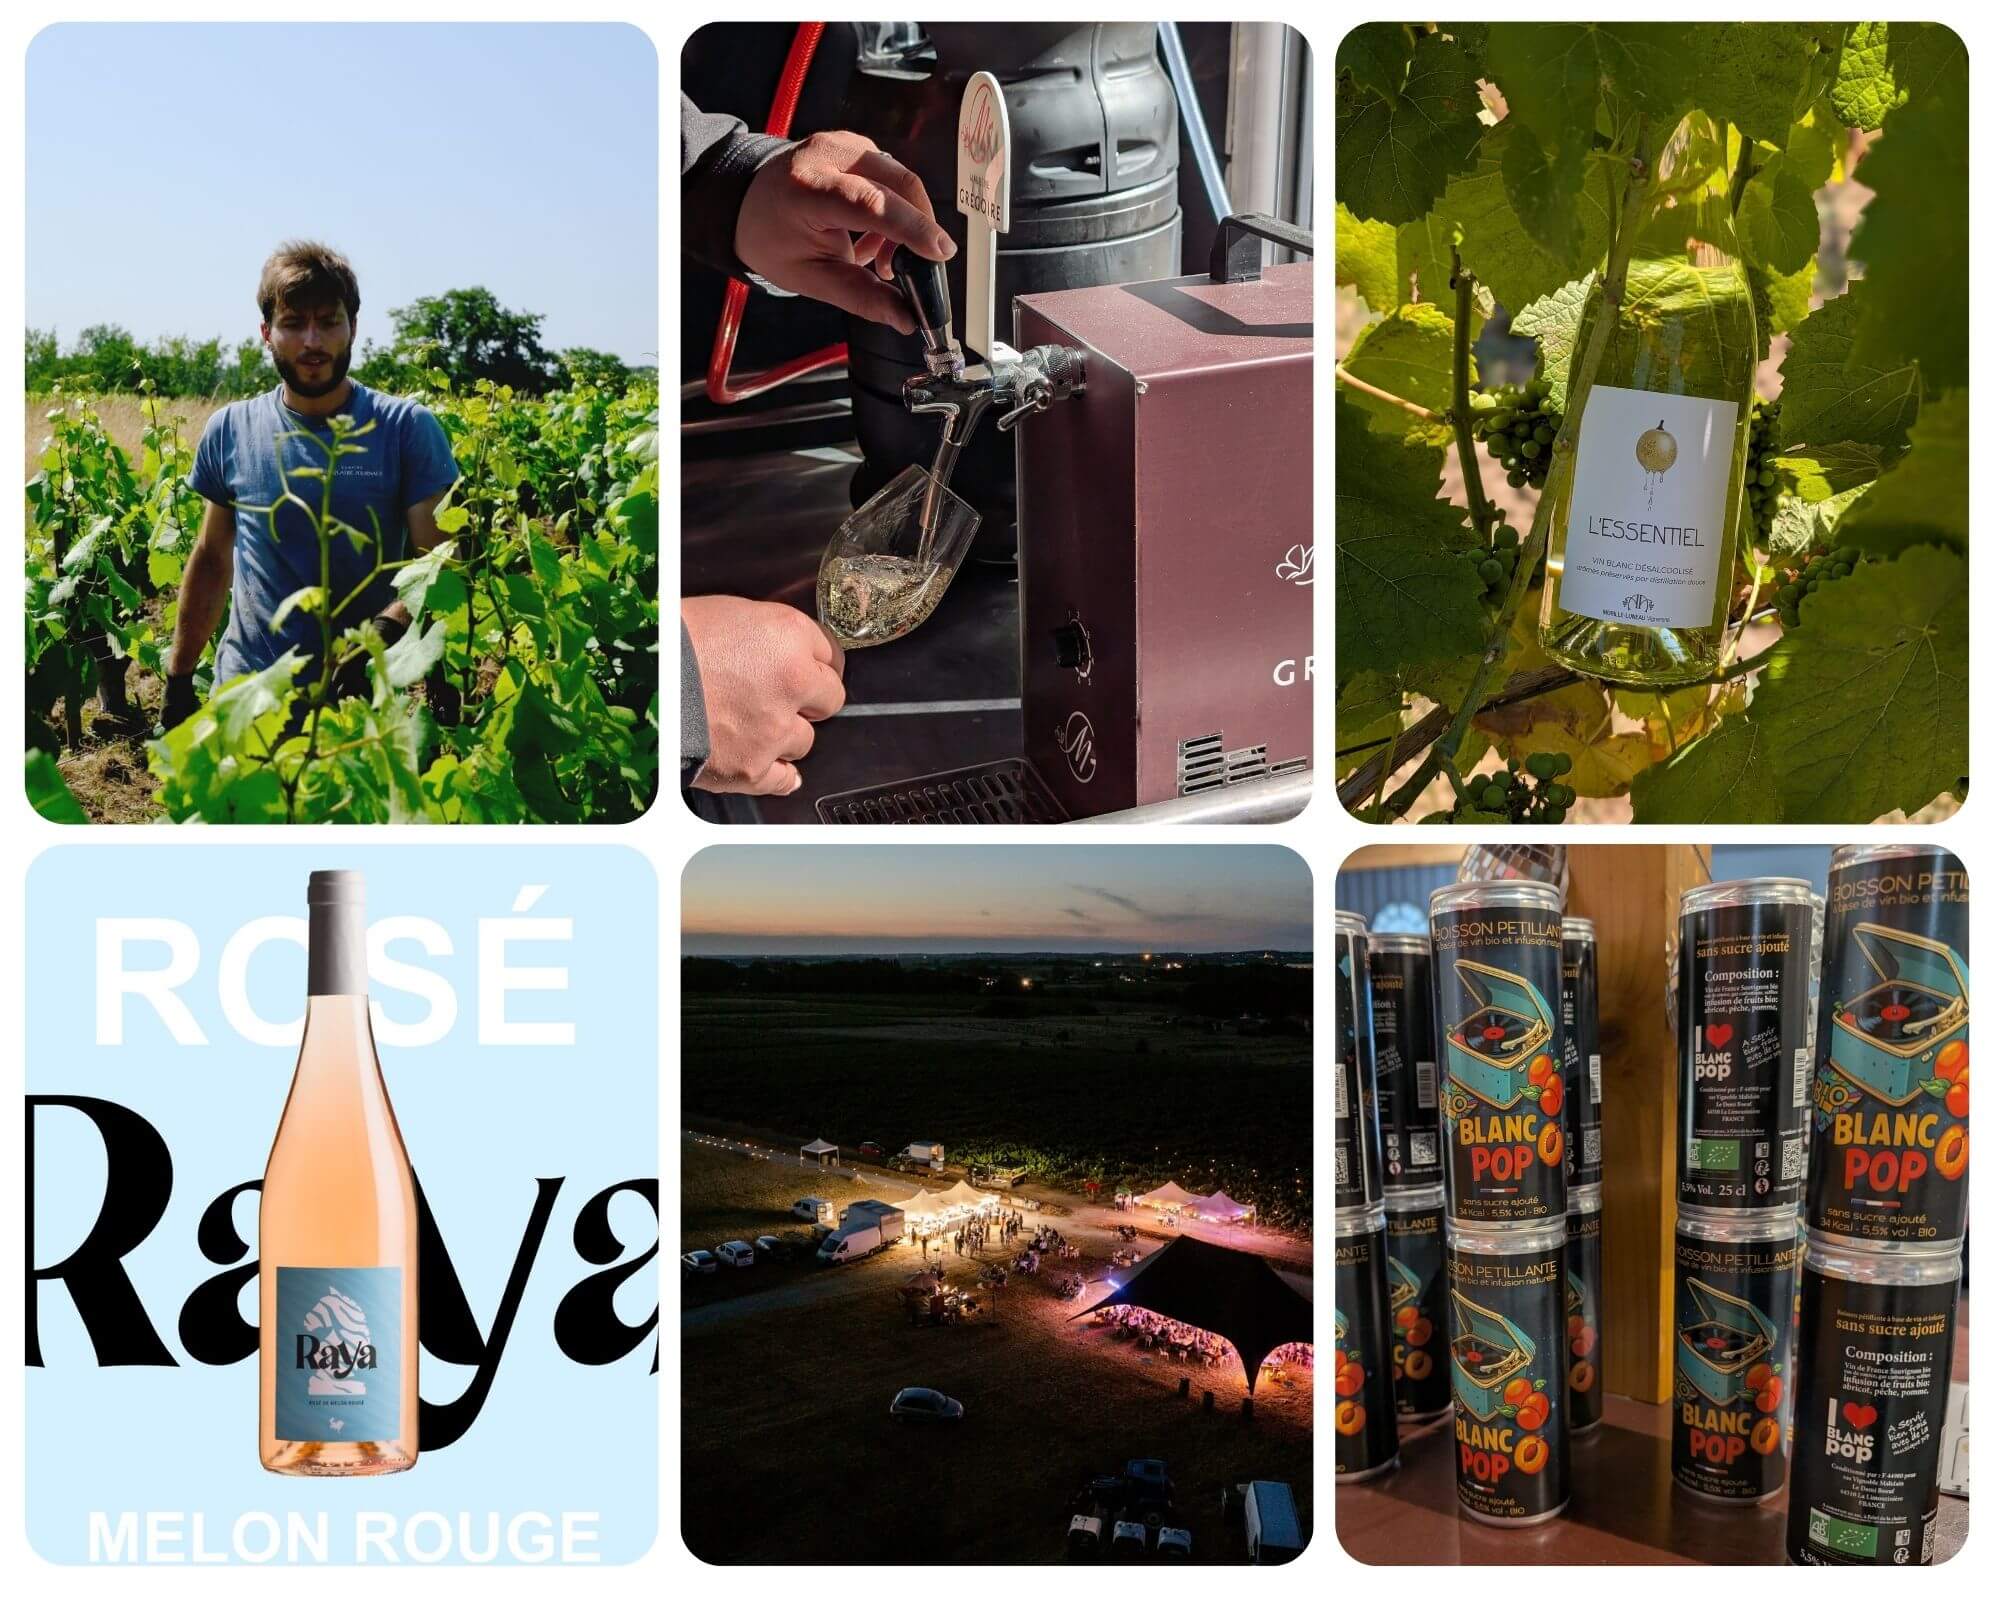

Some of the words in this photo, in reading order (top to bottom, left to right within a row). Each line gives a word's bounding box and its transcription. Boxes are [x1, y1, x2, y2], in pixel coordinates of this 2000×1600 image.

[1588, 515, 1705, 547] L'ESSENTIEL
[1592, 557, 1605, 565] VIN
[1606, 560, 1634, 570] BLANC
[1833, 875, 1913, 902] BOISSON
[1880, 894, 1896, 905] vin
[1899, 893, 1920, 904] bio
[1435, 920, 1493, 942] BOISSON
[1471, 938, 1484, 946] vin
[1486, 936, 1501, 945] bio
[1502, 936, 1513, 945] et
[1515, 935, 1547, 946] infusion
[1696, 947, 1719, 958] sans
[1721, 943, 1753, 955] sucre
[1755, 938, 1790, 956] ajouté
[95, 884, 575, 1047] ROSÉ
[1704, 967, 1773, 983] Composition
[1733, 996, 1743, 1005] de
[1743, 995, 1763, 1004] fruits
[1695, 1025, 1702, 1052] I
[1695, 1052, 1732, 1065] BLANC
[1695, 1064, 1732, 1081] pop
[1460, 1114, 1537, 1146] BLANC
[1833, 1112, 1939, 1149] BLANC
[1471, 1145, 1534, 1182] POP
[1843, 1147, 1928, 1193] POP
[1719, 1184, 1733, 1196] 25
[1735, 1184, 1746, 1196] cl
[1483, 1198, 1510, 1206] sucre
[1510, 1195, 1539, 1207] ajouté
[1513, 1207, 1527, 1216] vol
[1820, 1217, 1831, 1227] 34
[1832, 1219, 1854, 1232] Kcal
[1891, 1226, 1909, 1237] vol
[1918, 1227, 1937, 1238] BIO
[1827, 1208, 1851, 1218] sans
[1853, 1211, 1887, 1223] sucre
[1889, 1213, 1928, 1226] ajouté
[25, 1094, 660, 1452] Raya
[1476, 1260, 1557, 1279] PETILLANTE
[1713, 1265, 1727, 1273] bio
[1729, 1266, 1738, 1274] et
[1480, 1279, 1490, 1287] et
[1491, 1278, 1525, 1288] infusion
[1836, 1319, 1865, 1333] sans
[1868, 1324, 1907, 1336] sucre
[1910, 1317, 1945, 1340] ajouté
[296, 1334, 378, 1379] Raya
[1845, 1345, 1927, 1365] Composition
[1844, 1361, 1856, 1370] Vin
[1856, 1363, 1866, 1371] de
[1866, 1365, 1889, 1374] France
[1843, 1374, 1878, 1387] infusion
[1880, 1379, 1891, 1388] de
[1893, 1379, 1915, 1389] fruits
[1682, 1402, 1752, 1435] BLANC
[1827, 1397, 1838, 1427] I
[1455, 1416, 1513, 1454] BLANC
[1826, 1425, 1875, 1448] BLANC
[1689, 1427, 1746, 1465] POP
[1825, 1438, 1873, 1464] pop
[1461, 1442, 1510, 1484] POP
[1858, 1500, 1886, 1509] FRANCE
[89, 1511, 329, 1564] MELON
[355, 1511, 601, 1564] ROUGE
